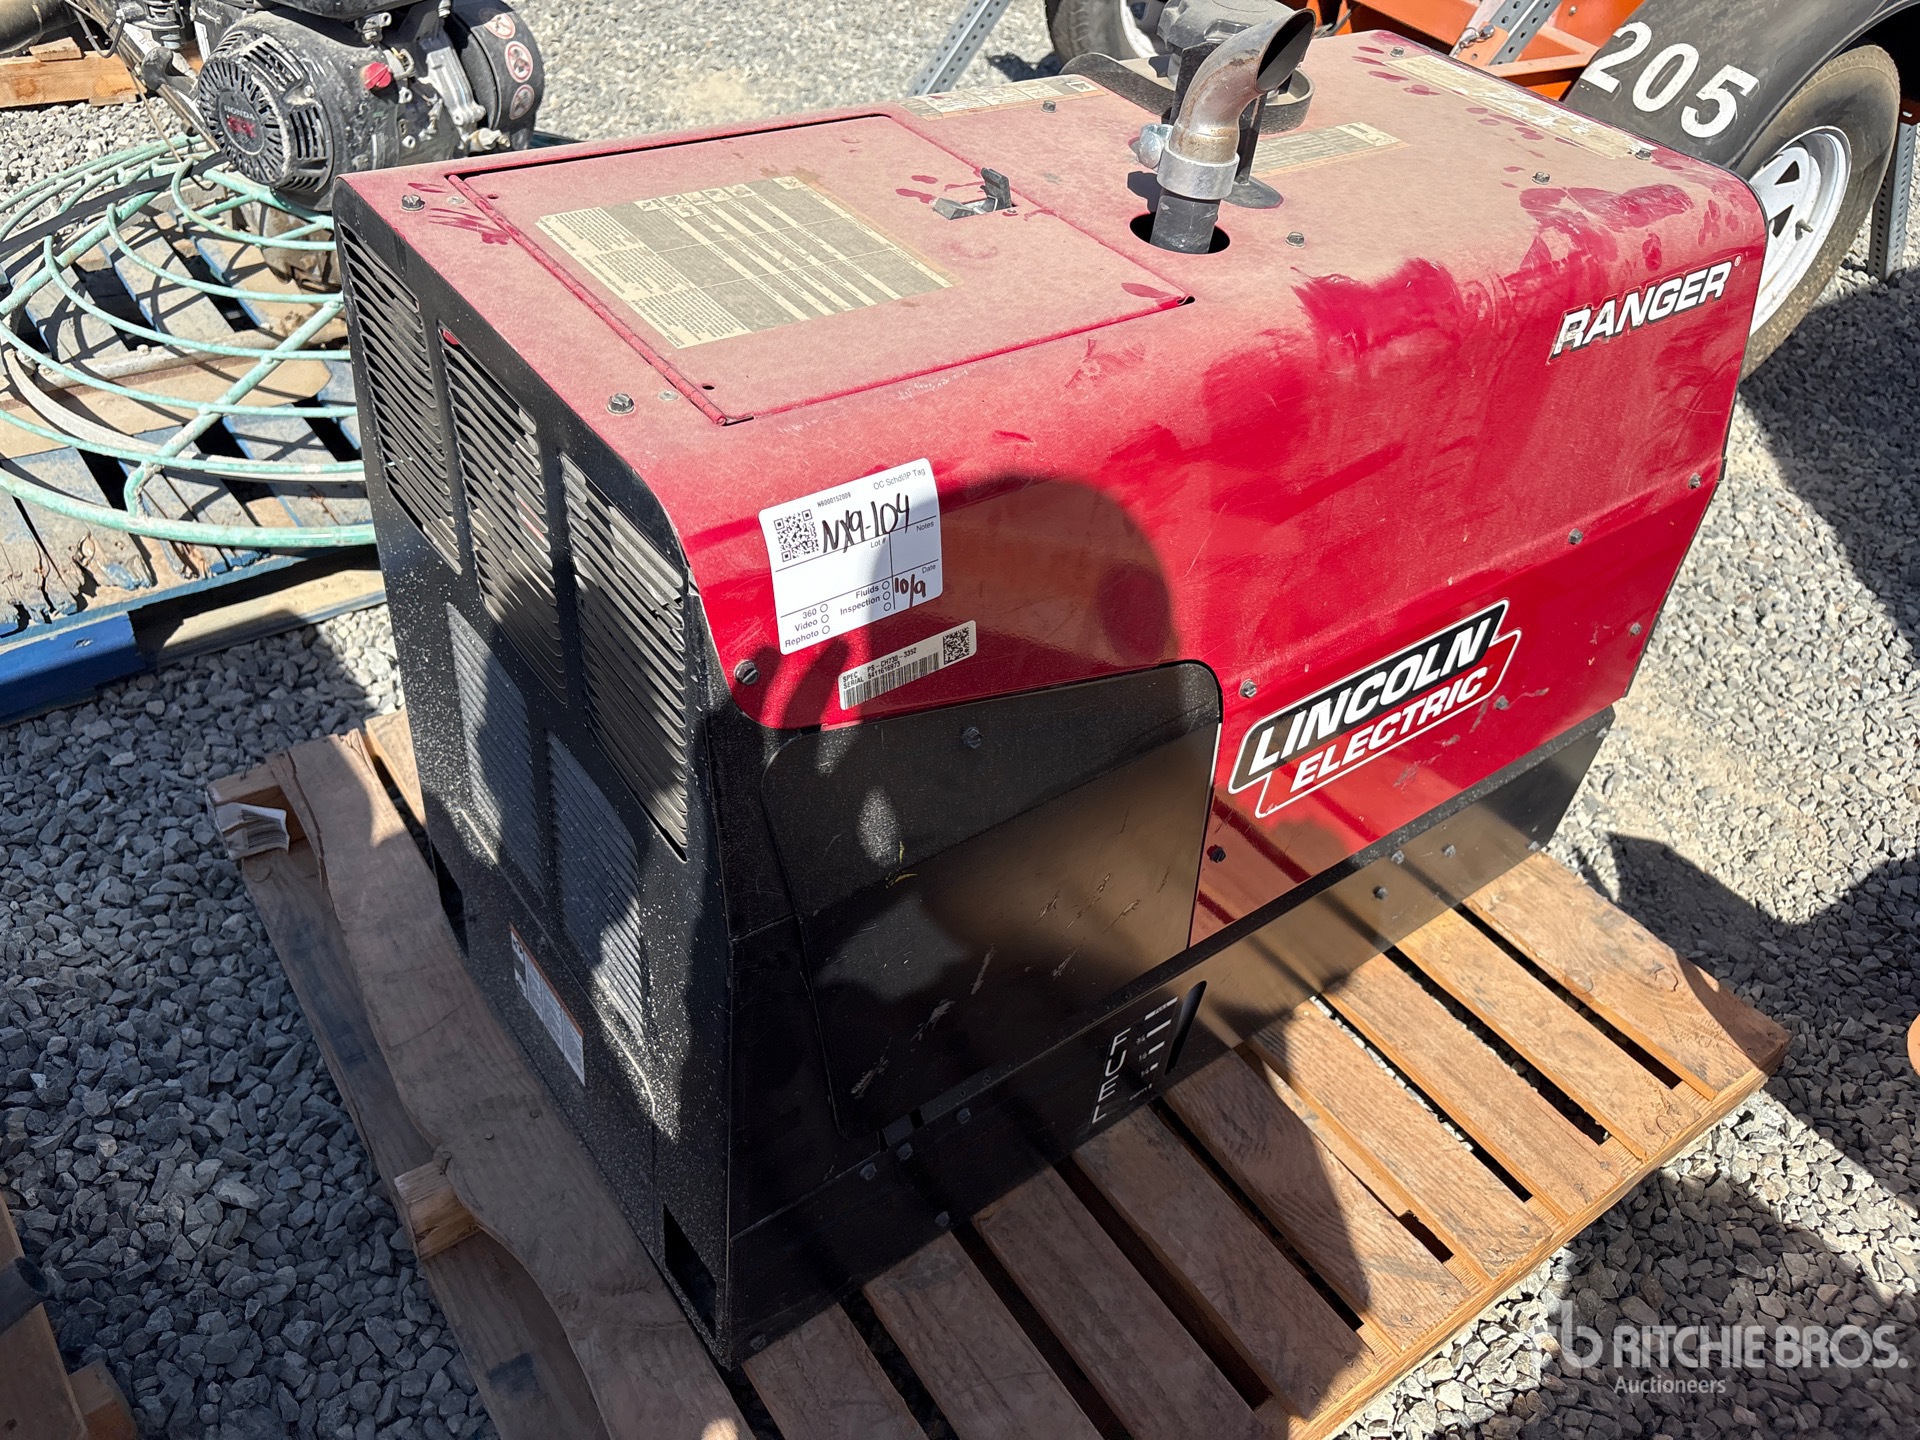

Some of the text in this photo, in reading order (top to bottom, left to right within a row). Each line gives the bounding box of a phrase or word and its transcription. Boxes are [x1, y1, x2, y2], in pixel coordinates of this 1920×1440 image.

[1580, 21, 1759, 138] 205
[223, 104, 256, 121] HONDA
[1552, 261, 1732, 356] RANGER
[873, 480, 885, 490] OC
[912, 468, 926, 477] Tag
[916, 520, 935, 532] Notes
[870, 540, 881, 549] Lot
[922, 564, 937, 574] Date
[855, 585, 880, 599] Fluids
[802, 608, 817, 619] 360
[840, 596, 881, 616] Inspection
[794, 619, 819, 632] Video
[784, 630, 820, 648] Rephoto
[842, 672, 859, 683] SPEC
[843, 677, 865, 690] SERIAL
[1248, 617, 1492, 776] LINCOLN
[1290, 666, 1488, 793] ELECTRIC
[1091, 1027, 1132, 1124] FUEL
